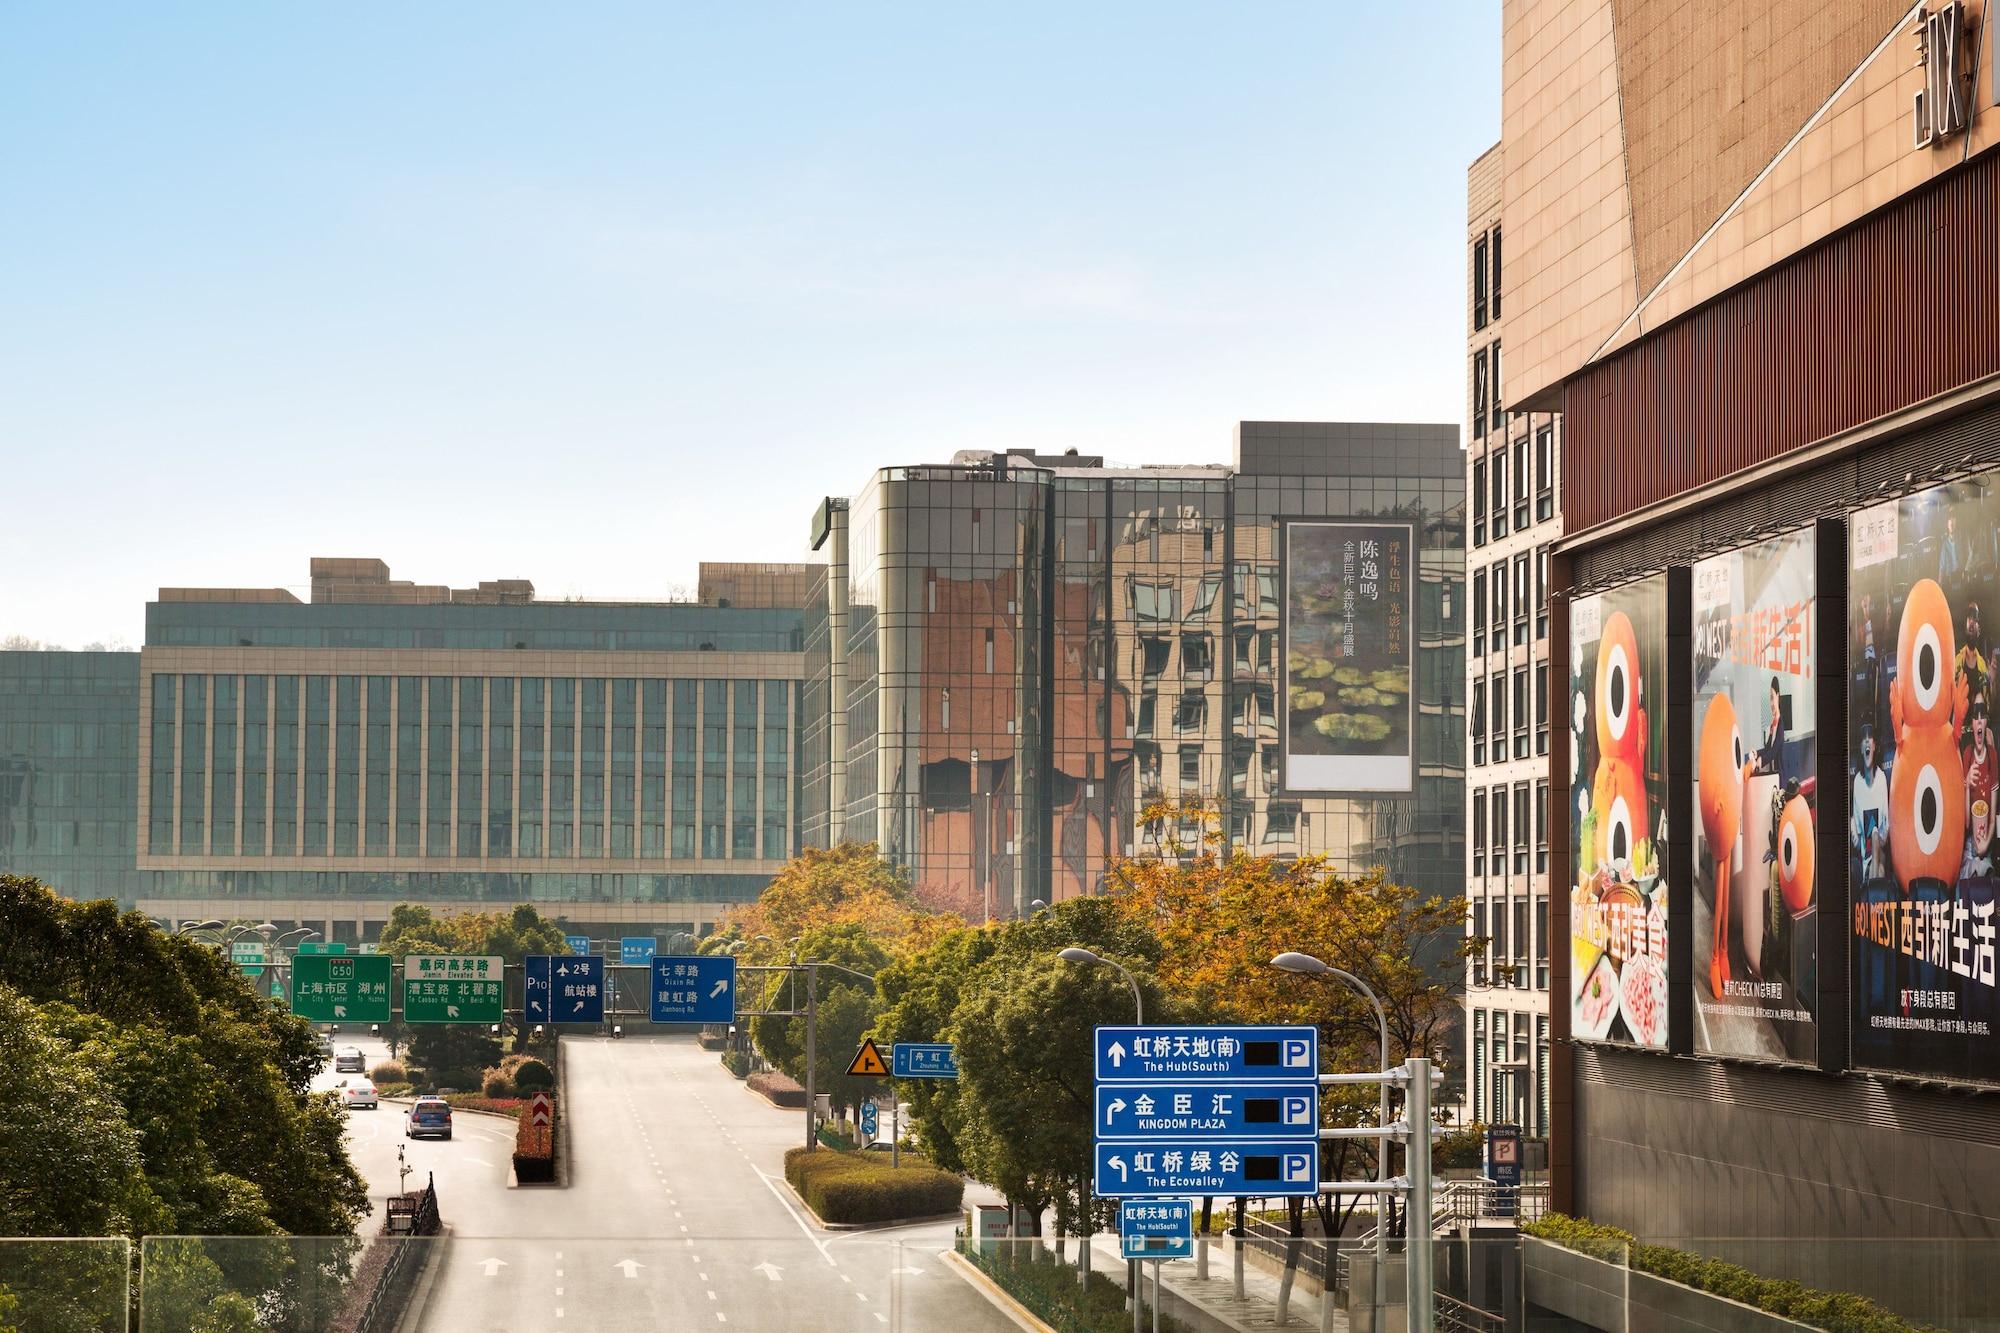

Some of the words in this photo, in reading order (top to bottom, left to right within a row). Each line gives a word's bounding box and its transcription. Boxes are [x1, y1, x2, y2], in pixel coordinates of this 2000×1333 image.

[1343, 540, 1355, 586] 全新巨作
[1360, 540, 1379, 601] 陈逸鸣
[1343, 589, 1355, 657] 金秋十月盛展
[1706, 619, 1727, 660] WEST
[1855, 902, 1869, 938] GO!
[1870, 901, 1897, 950] WEST
[1900, 898, 1996, 988] 西引新生活
[332, 966, 352, 976] G50
[419, 959, 489, 971] 嘉闵高架路
[573, 963, 590, 976] 2号
[659, 964, 699, 977] 七莘路
[297, 982, 348, 995] 上海市区
[357, 982, 386, 995] 湖州
[527, 977, 547, 990] P10
[564, 985, 597, 997] 航站楼
[658, 991, 698, 1003] 建虹路
[1901, 989, 1956, 1010] 放下身段总有原因
[1133, 1036, 1241, 1058] 虹桥天地(南)
[1287, 1042, 1306, 1066] P
[1144, 1061, 1164, 1072] The
[1166, 1061, 1229, 1072] Hub(South)
[1134, 1094, 1232, 1116] 金臣汇
[1287, 1098, 1306, 1123] P
[1138, 1119, 1187, 1129] KINGDOM
[1191, 1119, 1226, 1129] PLAZA
[1134, 1151, 1240, 1173] 虹桥绿谷
[1287, 1156, 1306, 1180] P
[1147, 1177, 1166, 1187] The
[1170, 1177, 1224, 1188] Ecovalley
[1125, 1207, 1188, 1220] 虹桥天地(南)
